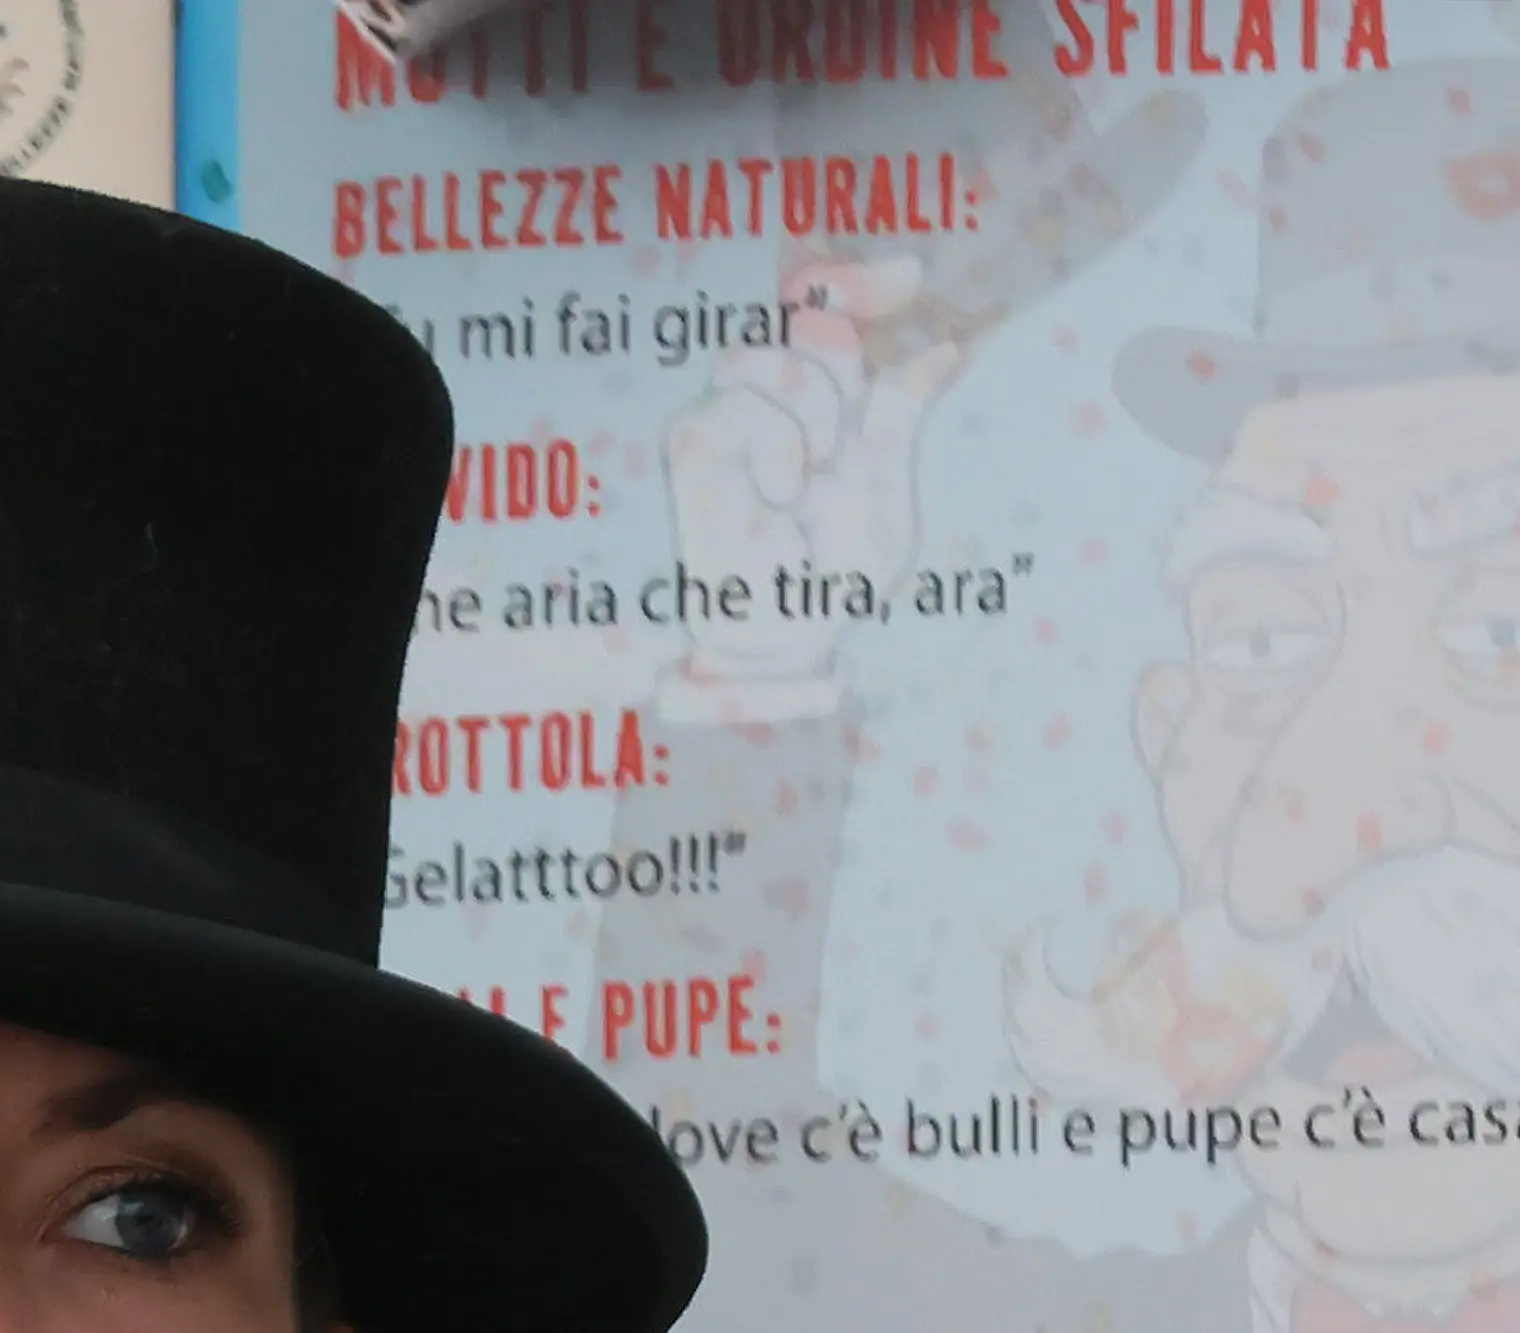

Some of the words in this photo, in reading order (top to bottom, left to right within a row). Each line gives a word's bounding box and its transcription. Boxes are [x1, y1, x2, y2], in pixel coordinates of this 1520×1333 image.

[332, 163, 625, 258] BELLEZZE
[653, 151, 979, 241] NATURALI:
[459, 295, 535, 361] mi
[556, 292, 632, 356] fai
[503, 569, 619, 628] aria
[640, 559, 753, 625] che
[774, 558, 893, 626] tira,
[602, 972, 782, 1062] PUPE:
[650, 1105, 779, 1166] ove
[800, 1096, 882, 1164] c’è
[906, 1095, 1040, 1159] bulli
[1063, 1103, 1096, 1158] e
[1118, 1103, 1282, 1169] pupe
[1304, 1085, 1386, 1149] c’è
[1409, 1097, 1520, 1148] cas
